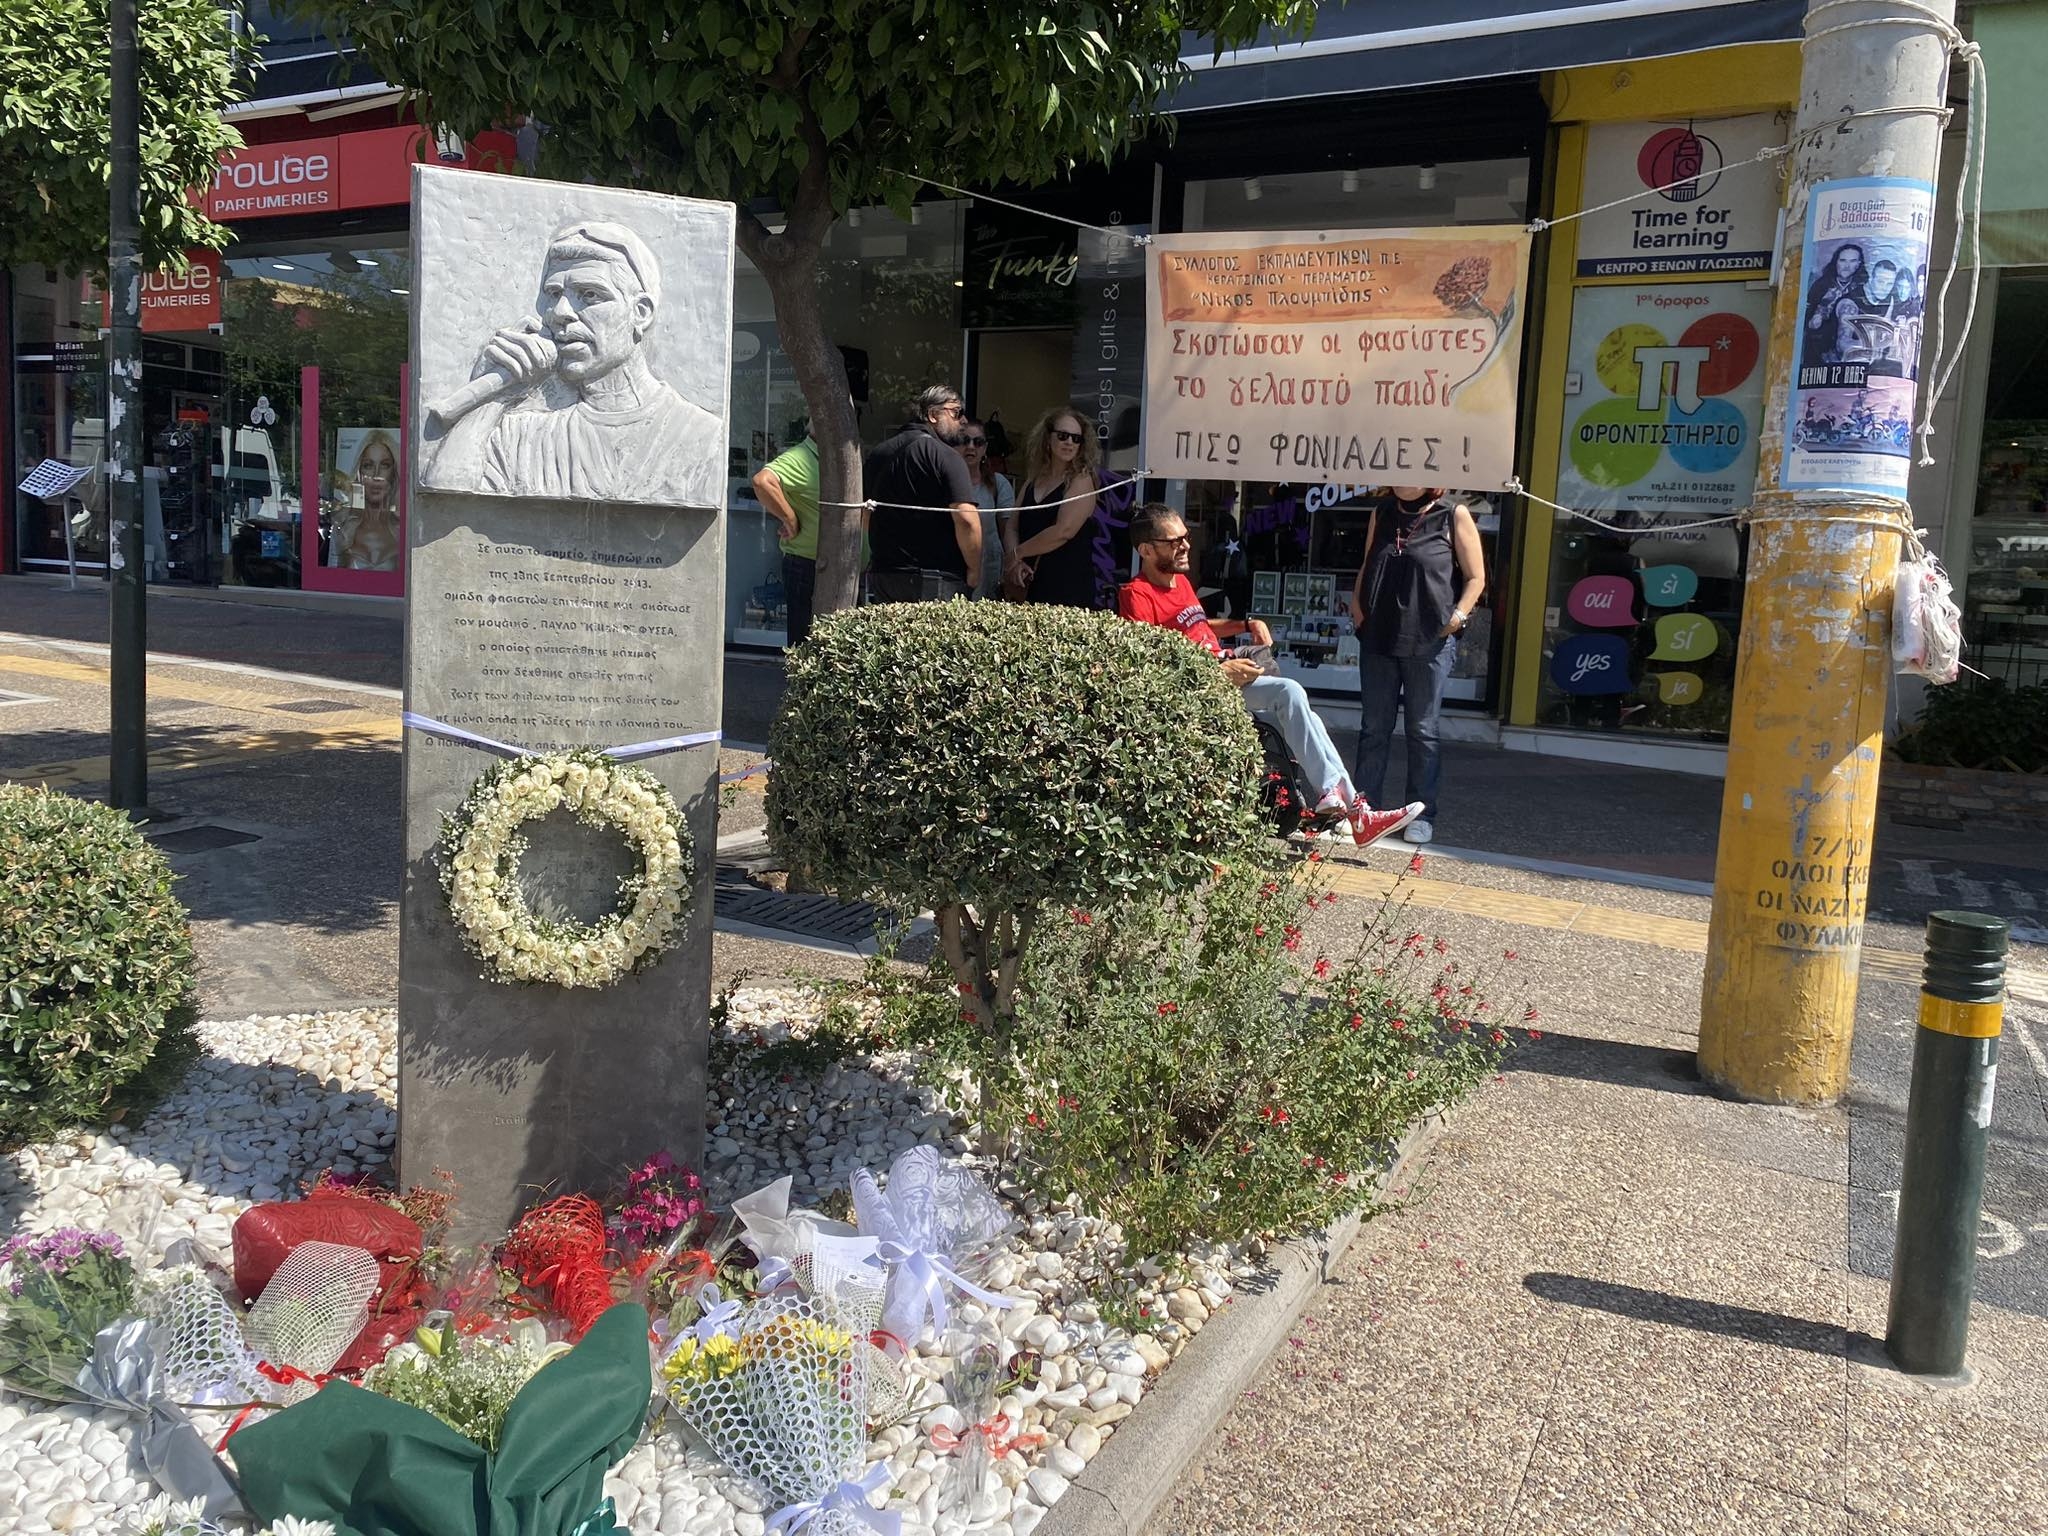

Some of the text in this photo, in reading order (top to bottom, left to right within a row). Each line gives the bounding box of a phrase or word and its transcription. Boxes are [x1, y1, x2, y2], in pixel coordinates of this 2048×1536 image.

[215, 191, 328, 212] PARFUMERIES
[1632, 205, 1731, 228] Time for
[1633, 228, 1729, 250] learning
[1174, 256, 1240, 271] ΣΥΛΛΟΓΟΣ
[1257, 249, 1371, 269] ΕΚΠΑΙΔΕΥΤΙΚΩΝ
[1596, 257, 1764, 274] ΚΕΝΤΡΟ ΞΕΝΩΝ ΓΛΩΣΣΩΝ
[1206, 273, 1285, 287] ΚΕΡΑΤΣΙΝΙΟΥ
[1302, 270, 1376, 287] ΠΕΡΑΜΑΤΟΣ
[141, 293, 210, 308] FUMERIES
[1103, 282, 1120, 300] &
[1654, 295, 1710, 309] όροφος
[1099, 308, 1118, 360] gifts
[1322, 334, 1341, 353] οι
[1359, 325, 1486, 362] φασίστες
[55, 342, 84, 350] Radiant
[1801, 366, 1828, 385] BEHIND
[1831, 366, 1841, 384] 12
[1174, 369, 1450, 407] το γελαστό παιδί
[1097, 379, 1116, 439] bags
[1580, 424, 1740, 445] ΦΡΟΝΤΙΣΤΗΡΙΟ
[1176, 431, 1240, 465] ΠΙΣΩ
[1270, 432, 1442, 472] ΦΟΝΙΑΔΕΣ
[478, 543, 490, 554] Σε
[528, 547, 540, 556] το
[489, 570, 508, 581] της
[1584, 589, 1615, 608] oui
[455, 618, 474, 626] τον
[540, 620, 577, 630] ΠΑΥΛΟ
[491, 642, 530, 655] οποίος
[1570, 652, 1611, 682] yes
[1668, 680, 1688, 699] ja
[1772, 859, 1833, 883] ΟΛΟΙ
[1757, 890, 1782, 911] ΟΙ
[1776, 922, 1862, 946] ΦΥΛΑΚΗ
